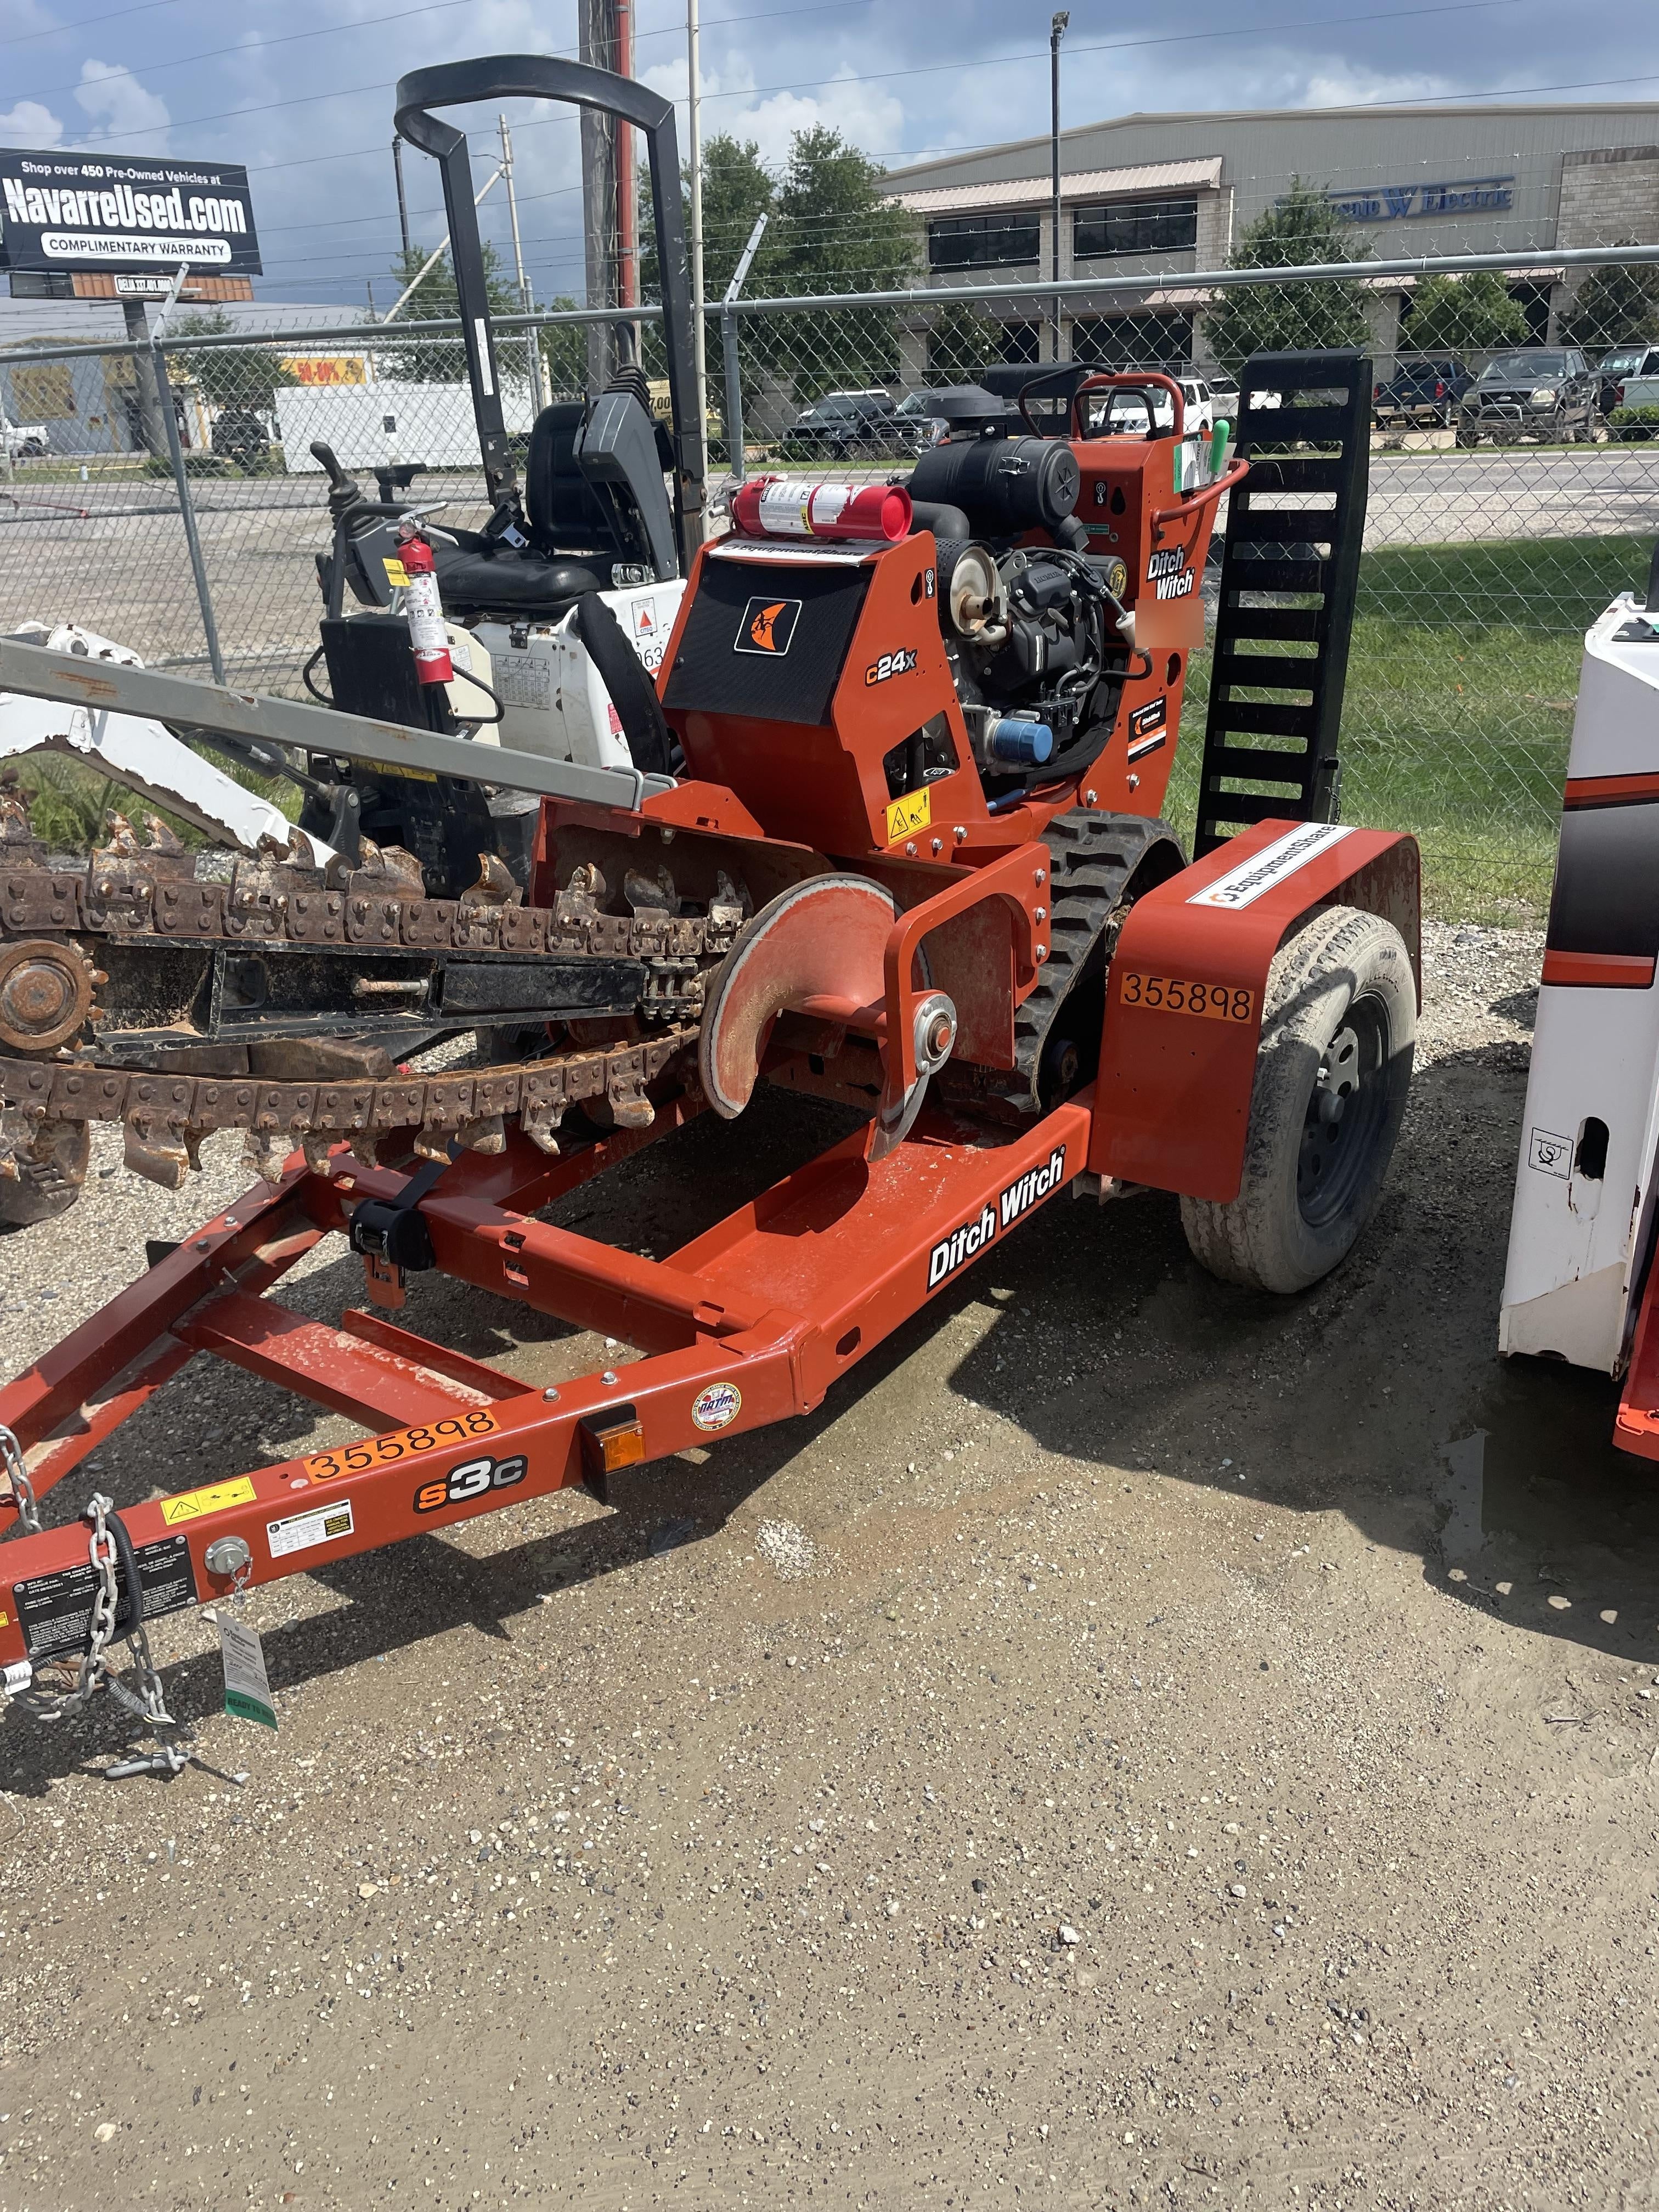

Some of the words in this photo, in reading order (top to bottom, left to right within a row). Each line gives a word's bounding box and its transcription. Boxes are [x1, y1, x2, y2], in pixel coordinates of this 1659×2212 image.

[21, 161, 52, 176] Shop
[54, 165, 79, 176] over
[81, 165, 104, 177] 450
[105, 166, 165, 182] Pre-Owned
[166, 171, 208, 184] Vehicles
[210, 174, 221, 185] at
[2, 178, 247, 234] NavarreUsed.com
[1421, 182, 1513, 212] Electric
[49, 239, 156, 255] COMPLIMENTARY
[159, 243, 225, 256] WARRANTY
[738, 545, 865, 556] EquipmentShare
[1147, 546, 1184, 580] Ditch
[1034, 571, 1063, 583] HONDA
[1156, 569, 1194, 599] Witch
[1223, 826, 1338, 893] EquipmentShare
[1124, 974, 1250, 1020] 355898
[929, 1207, 996, 1287] Ditch
[1001, 1152, 1063, 1226] Witch
[310, 1411, 494, 1480] 355898
[228, 1697, 250, 1711] READY
[252, 1704, 261, 1714] TO
